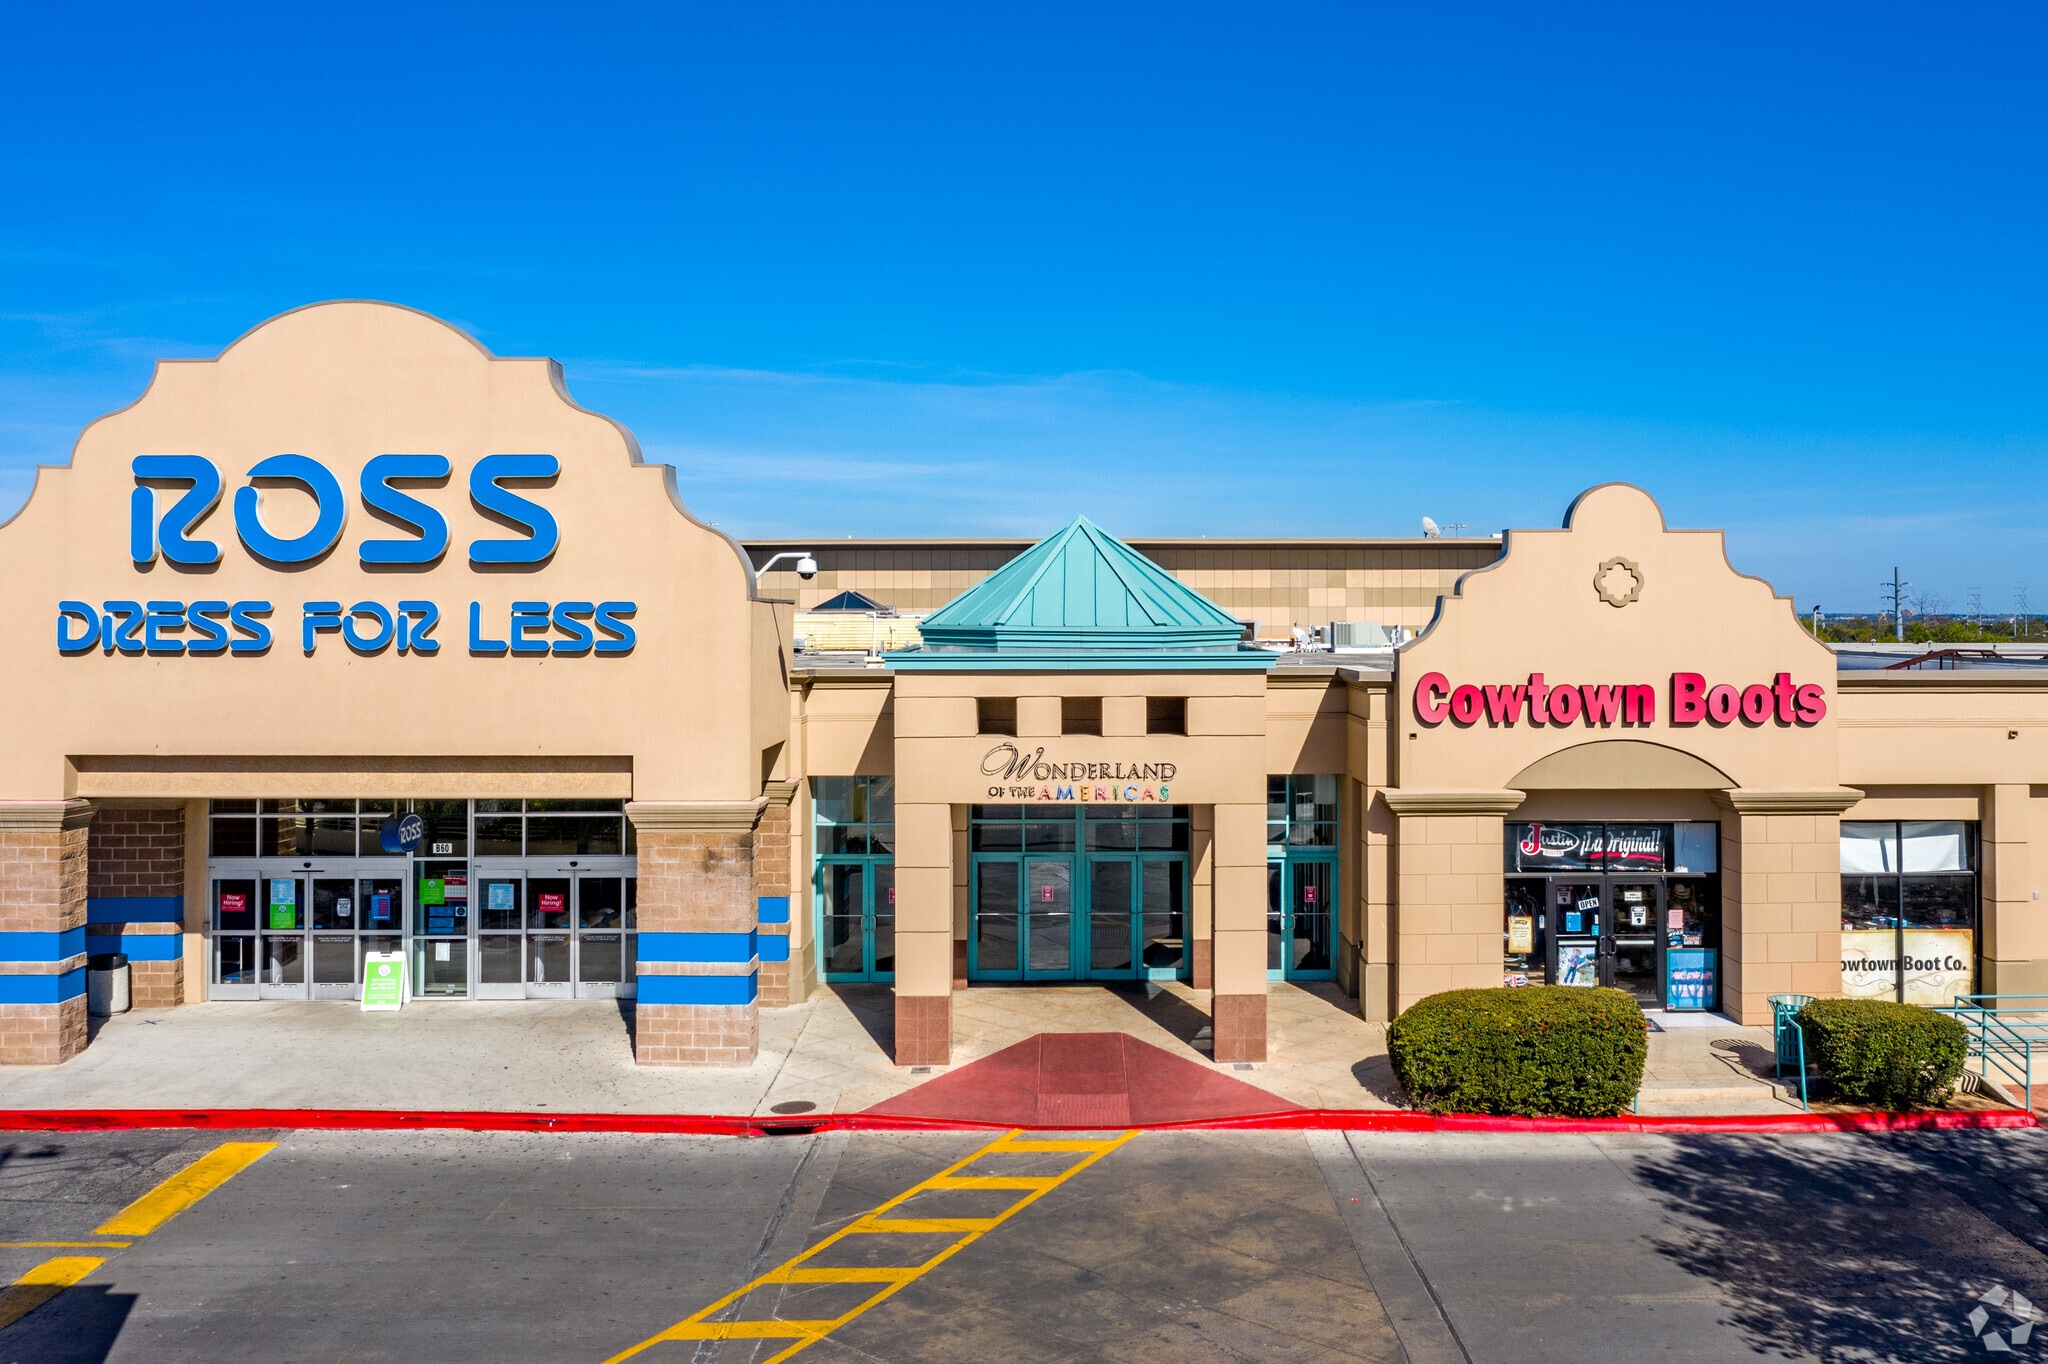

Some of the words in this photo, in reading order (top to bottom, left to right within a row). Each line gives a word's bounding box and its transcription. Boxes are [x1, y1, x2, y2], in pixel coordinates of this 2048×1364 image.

[130, 454, 561, 565] ROSS
[57, 600, 274, 653] DRESS
[302, 600, 441, 653] FOR
[469, 600, 637, 653] LESS
[1414, 671, 1656, 727] Cowtown
[1671, 671, 1827, 726] Boots
[981, 742, 1177, 782] WONDERLAND
[988, 786, 1005, 799] OF
[1008, 786, 1035, 798] THE
[1037, 784, 1169, 802] AMERICAS
[400, 822, 421, 844] ROSS
[1520, 823, 1574, 855] Justin
[1580, 898, 1597, 909] OPEN
[1840, 957, 1900, 971] owtown
[1902, 955, 1941, 970] Boot
[1944, 955, 1967, 971] Co.
